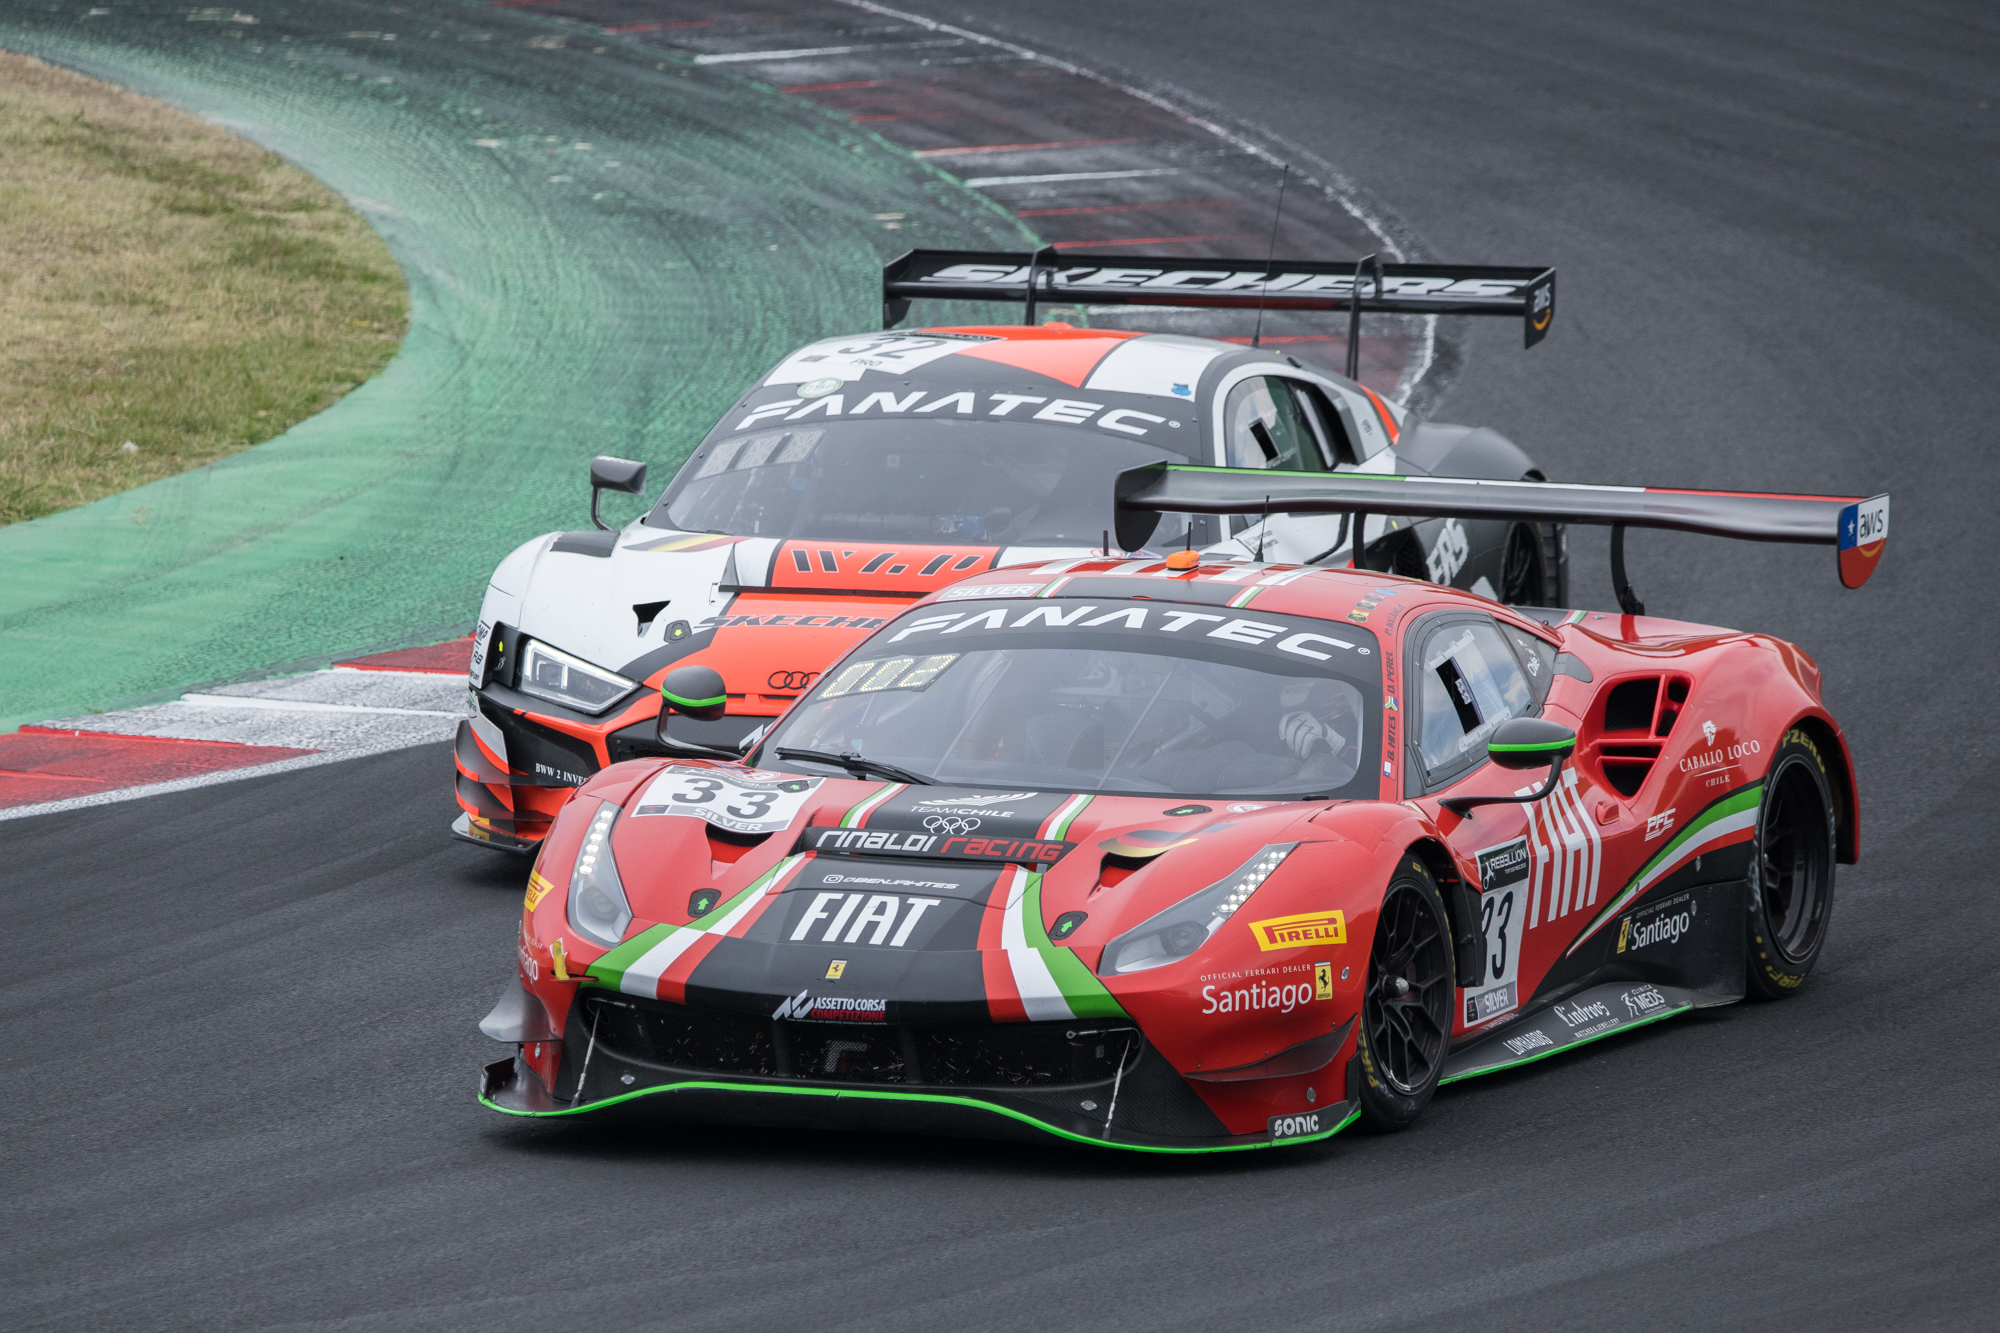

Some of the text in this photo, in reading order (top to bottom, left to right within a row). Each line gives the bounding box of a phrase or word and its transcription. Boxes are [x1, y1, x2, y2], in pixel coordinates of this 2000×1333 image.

[920, 263, 1530, 297] SKECHERS
[837, 337, 948, 359] 32
[850, 358, 883, 367] PRO
[734, 391, 1167, 436] FANATEC
[1859, 509, 1884, 538] aws
[947, 585, 1032, 599] SILVER
[887, 605, 1356, 661] FANATEC
[1385, 651, 1395, 683] PEREL
[1387, 714, 1396, 749] HITES
[1679, 740, 1761, 773] CABALLO LOCO
[535, 763, 555, 777] BWW
[556, 770, 561, 779] 2
[1705, 775, 1731, 788] CHILE
[671, 778, 779, 819] 33
[692, 808, 763, 831] SILVER
[1646, 808, 1676, 833] PFC
[1490, 848, 1527, 871] REBELLION
[1514, 767, 1602, 930] FIAT
[789, 892, 941, 947] FIAT
[1262, 917, 1339, 945] PIRELLI
[1631, 912, 1690, 951] Santiago
[1200, 964, 1312, 982] OFFICIAL FERRARI DEALER
[814, 997, 886, 1011] ASSETTO CORSA
[1202, 980, 1313, 1015] Santiago
[1484, 987, 1509, 1014] SILVER
[1633, 989, 1665, 1010] MEDS
[810, 1009, 886, 1021] COMPETIZIONE
[1553, 1001, 1611, 1027] Lindroos
